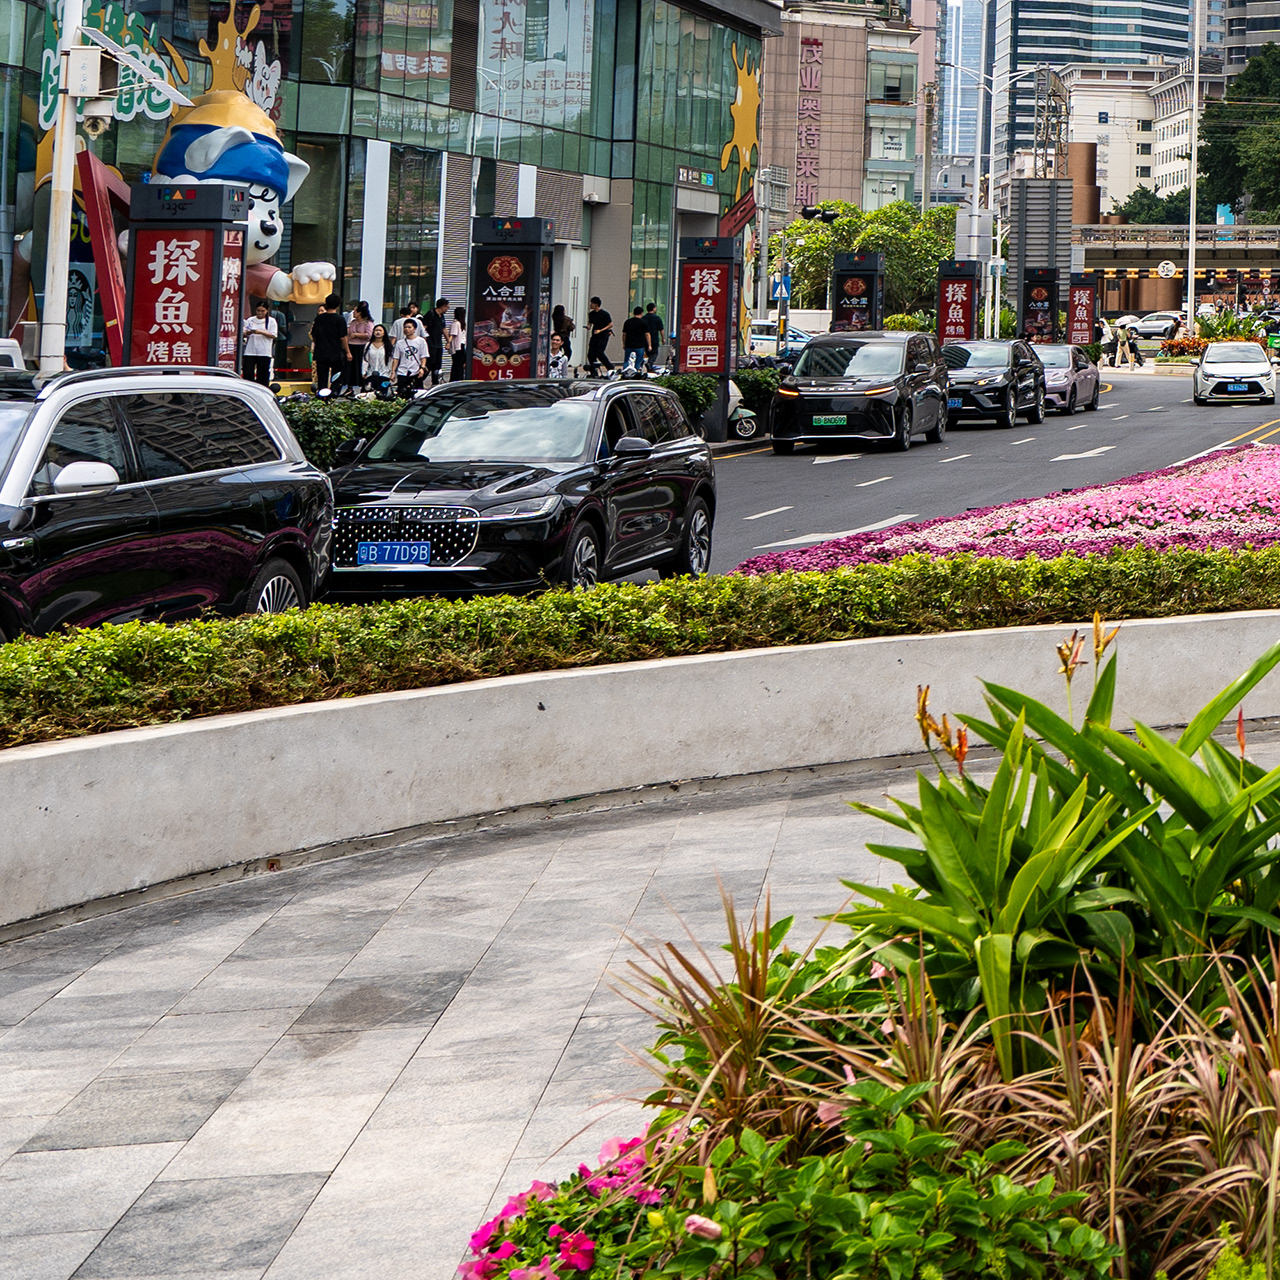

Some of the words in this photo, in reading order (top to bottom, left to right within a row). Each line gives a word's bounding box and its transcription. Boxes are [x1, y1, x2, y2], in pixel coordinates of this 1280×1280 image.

[147, 238, 201, 335] 探魚
[482, 286, 526, 297] 八合里
[690, 268, 721, 325] 探魚
[945, 283, 967, 323] 探魚
[1073, 290, 1090, 321] 探魚
[690, 328, 717, 342] 烤魚
[146, 341, 193, 363] 烤魚
[688, 353, 718, 366] 5F
[498, 369, 514, 380] L5
